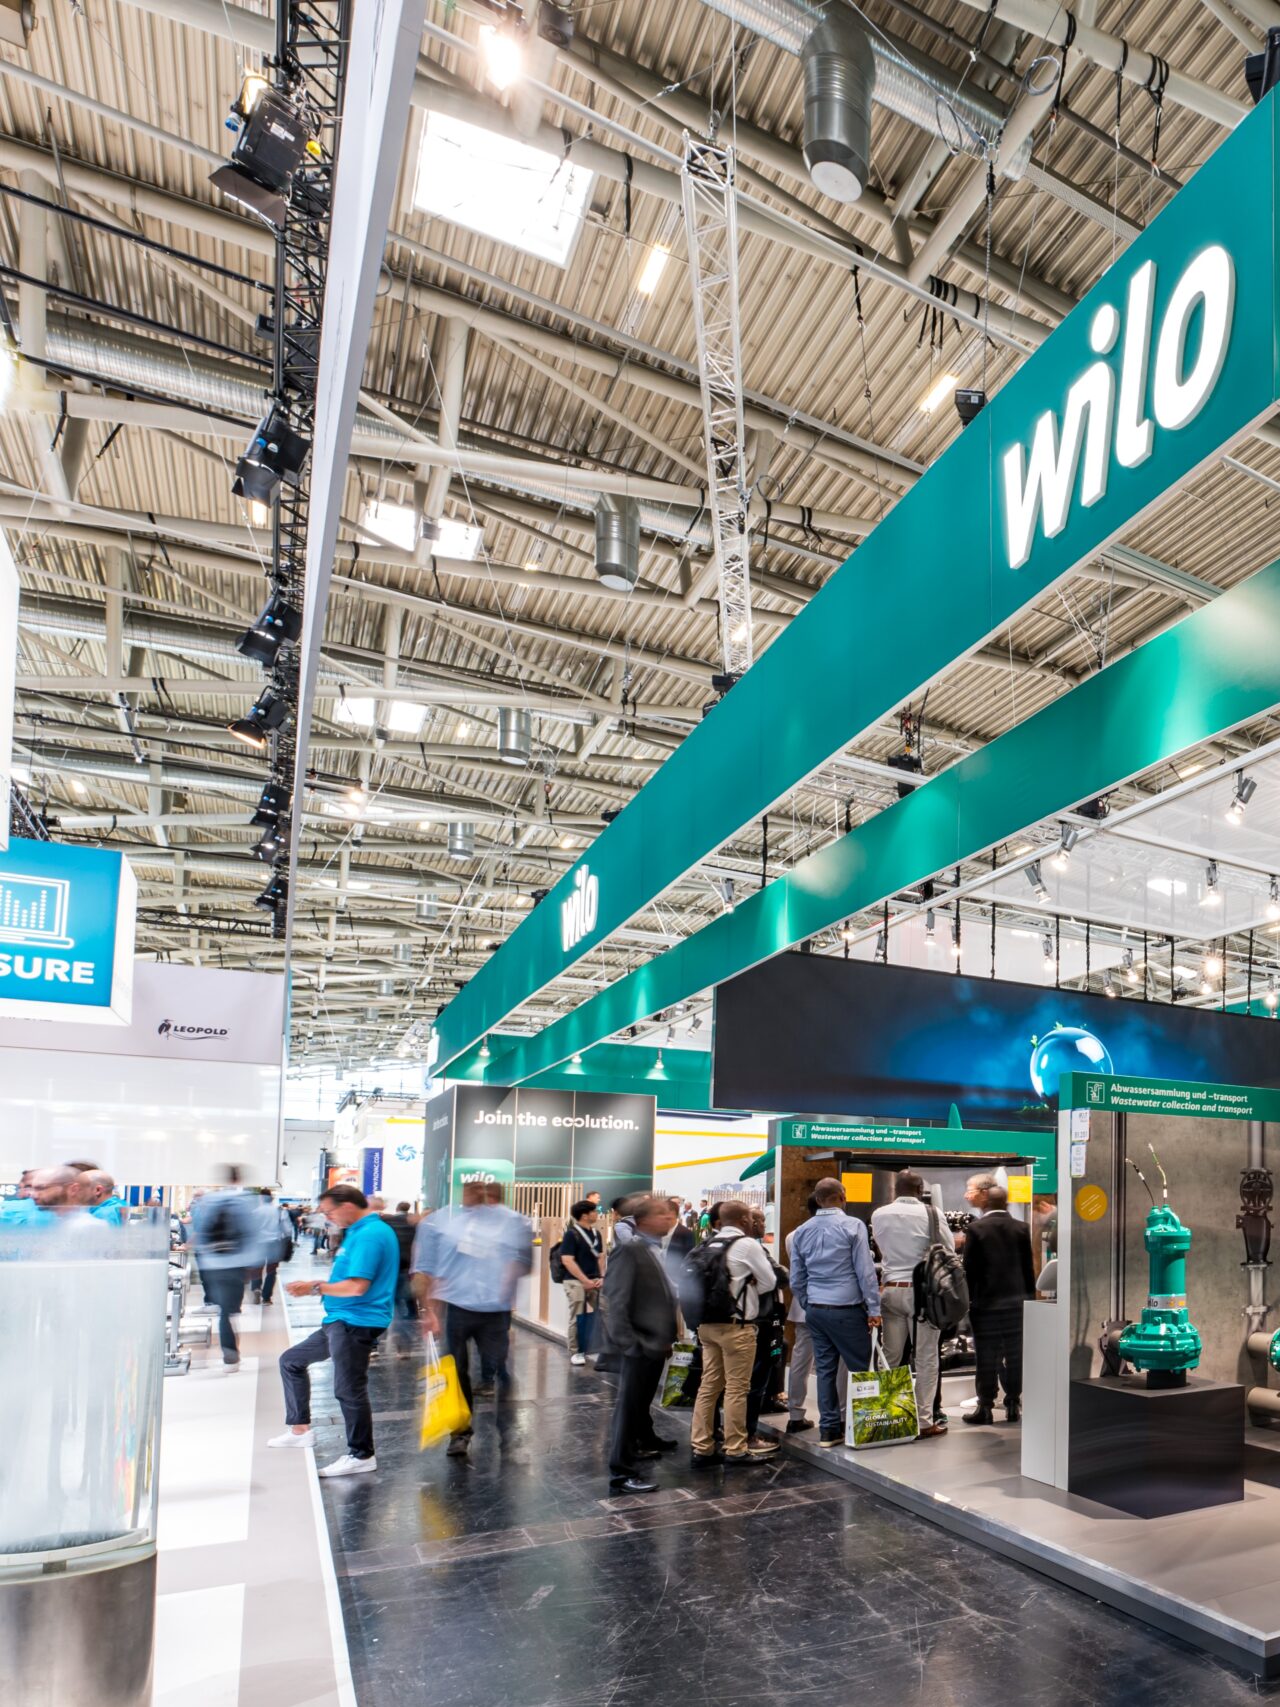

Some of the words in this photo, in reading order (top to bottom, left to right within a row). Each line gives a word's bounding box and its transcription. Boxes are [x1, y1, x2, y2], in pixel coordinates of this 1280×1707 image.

[1003, 245, 1236, 569] wilo
[562, 864, 599, 952] wilo
[173, 1025, 228, 1035] LEOPOLD
[1111, 1083, 1190, 1099] Abwassersammlung
[1192, 1090, 1207, 1099] und
[1111, 1096, 1160, 1108] Wastewater
[1162, 1098, 1201, 1111] collection
[1202, 1102, 1217, 1112] and
[1218, 1104, 1253, 1115] transport
[474, 1110, 513, 1125] Join
[517, 1112, 547, 1127] the
[811, 1125, 874, 1136] Abwassersammlung
[876, 1127, 888, 1135] und
[811, 1133, 850, 1142] Wastewater
[851, 1134, 882, 1142] collection
[896, 1136, 925, 1144] transport
[460, 1171, 495, 1185] wilo
